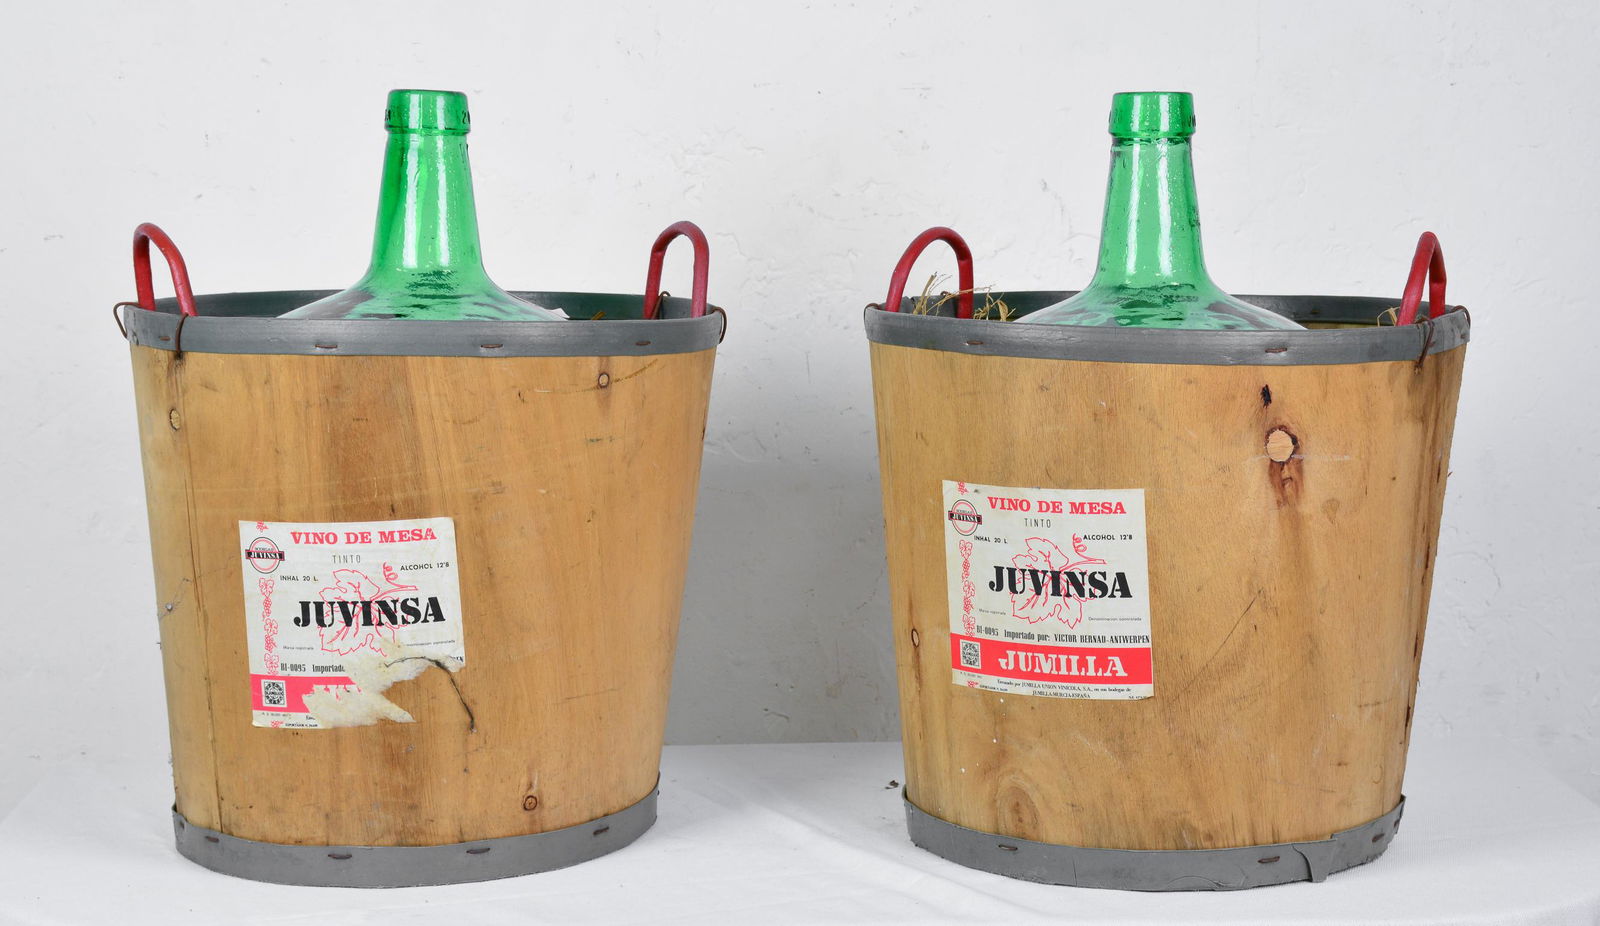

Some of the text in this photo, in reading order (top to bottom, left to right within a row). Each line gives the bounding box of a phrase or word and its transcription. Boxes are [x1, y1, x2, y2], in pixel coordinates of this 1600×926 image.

[987, 496, 1127, 515] VINO DE MESA
[952, 513, 978, 523] JUVINSA
[1024, 518, 1052, 528] TINTO
[290, 528, 437, 545] VINO DE MESA
[973, 535, 991, 543] INHAL
[250, 551, 280, 560] JUVINSA
[332, 554, 361, 564] TINTO
[400, 563, 433, 571] ALCOHOL
[989, 565, 1133, 599] JUVINSA
[293, 596, 446, 628] JUVINSA
[1004, 629, 1035, 641] Importado
[1037, 633, 1050, 643] por:
[1053, 633, 1078, 643] VICTOR
[998, 650, 1128, 677] JUMILLA
